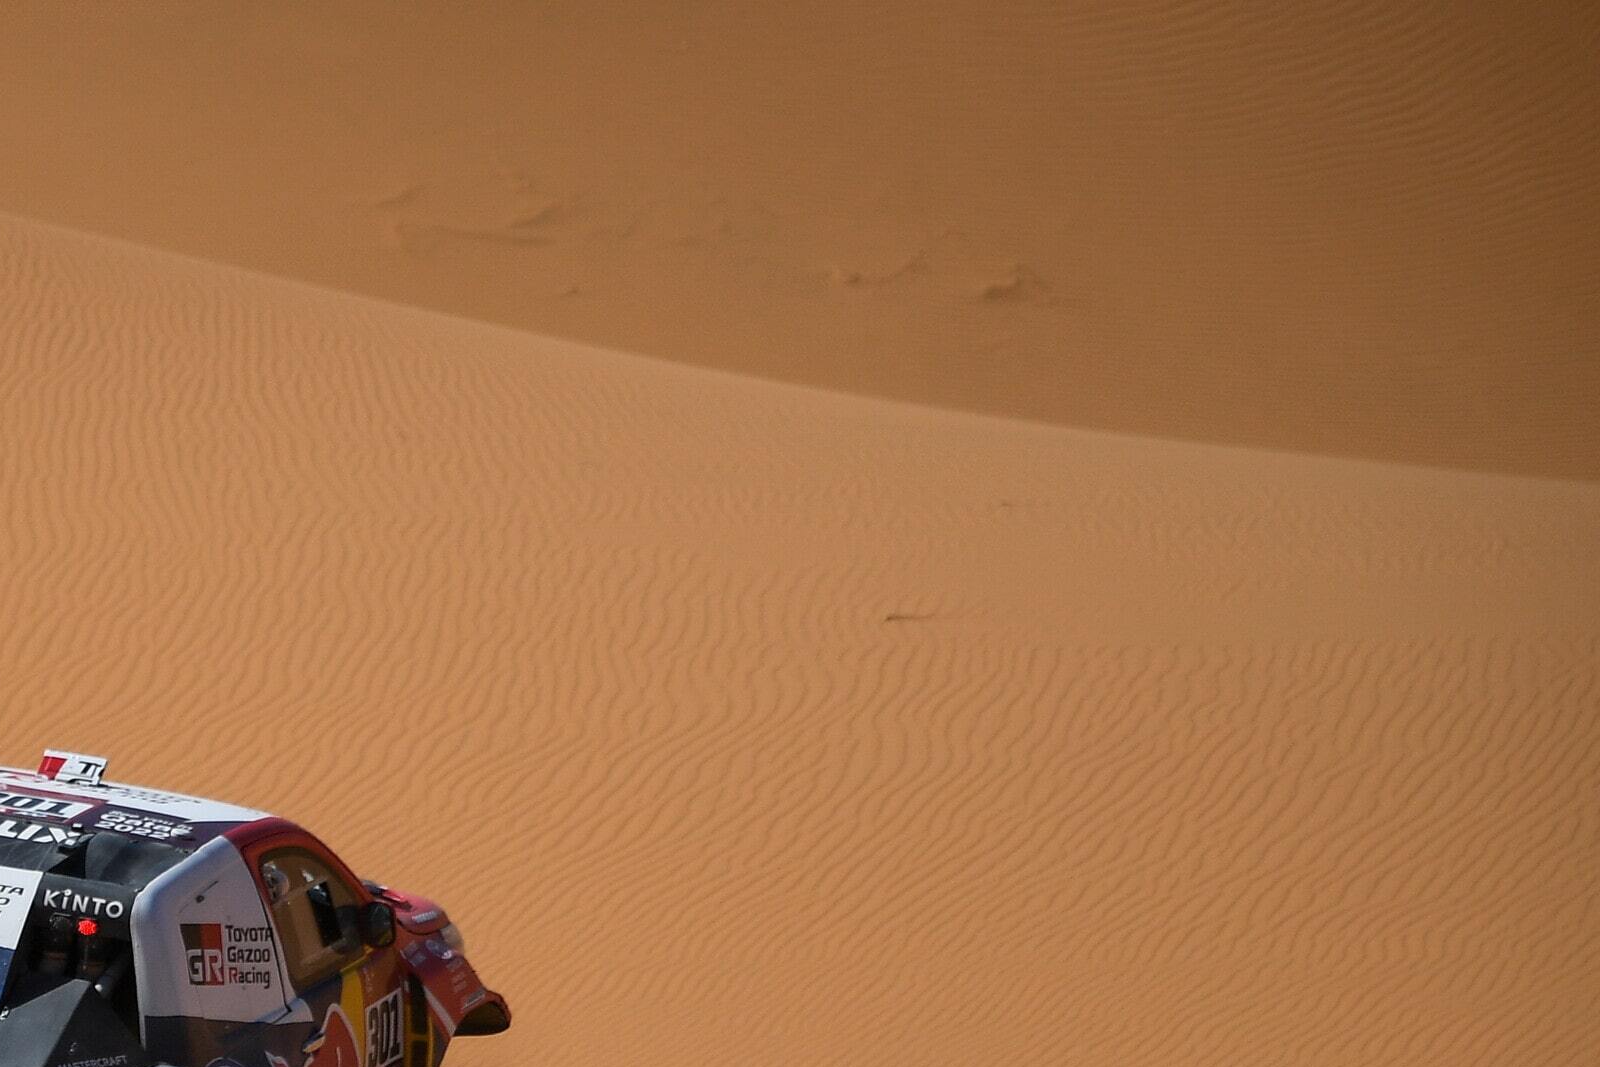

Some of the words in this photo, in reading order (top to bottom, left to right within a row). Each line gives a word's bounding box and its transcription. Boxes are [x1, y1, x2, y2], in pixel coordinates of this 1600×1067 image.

[94, 820, 170, 840] 2022
[224, 925, 273, 942] TOYOTA
[227, 946, 270, 963] GAZOO
[187, 948, 223, 982] GR
[228, 967, 270, 989] Racing
